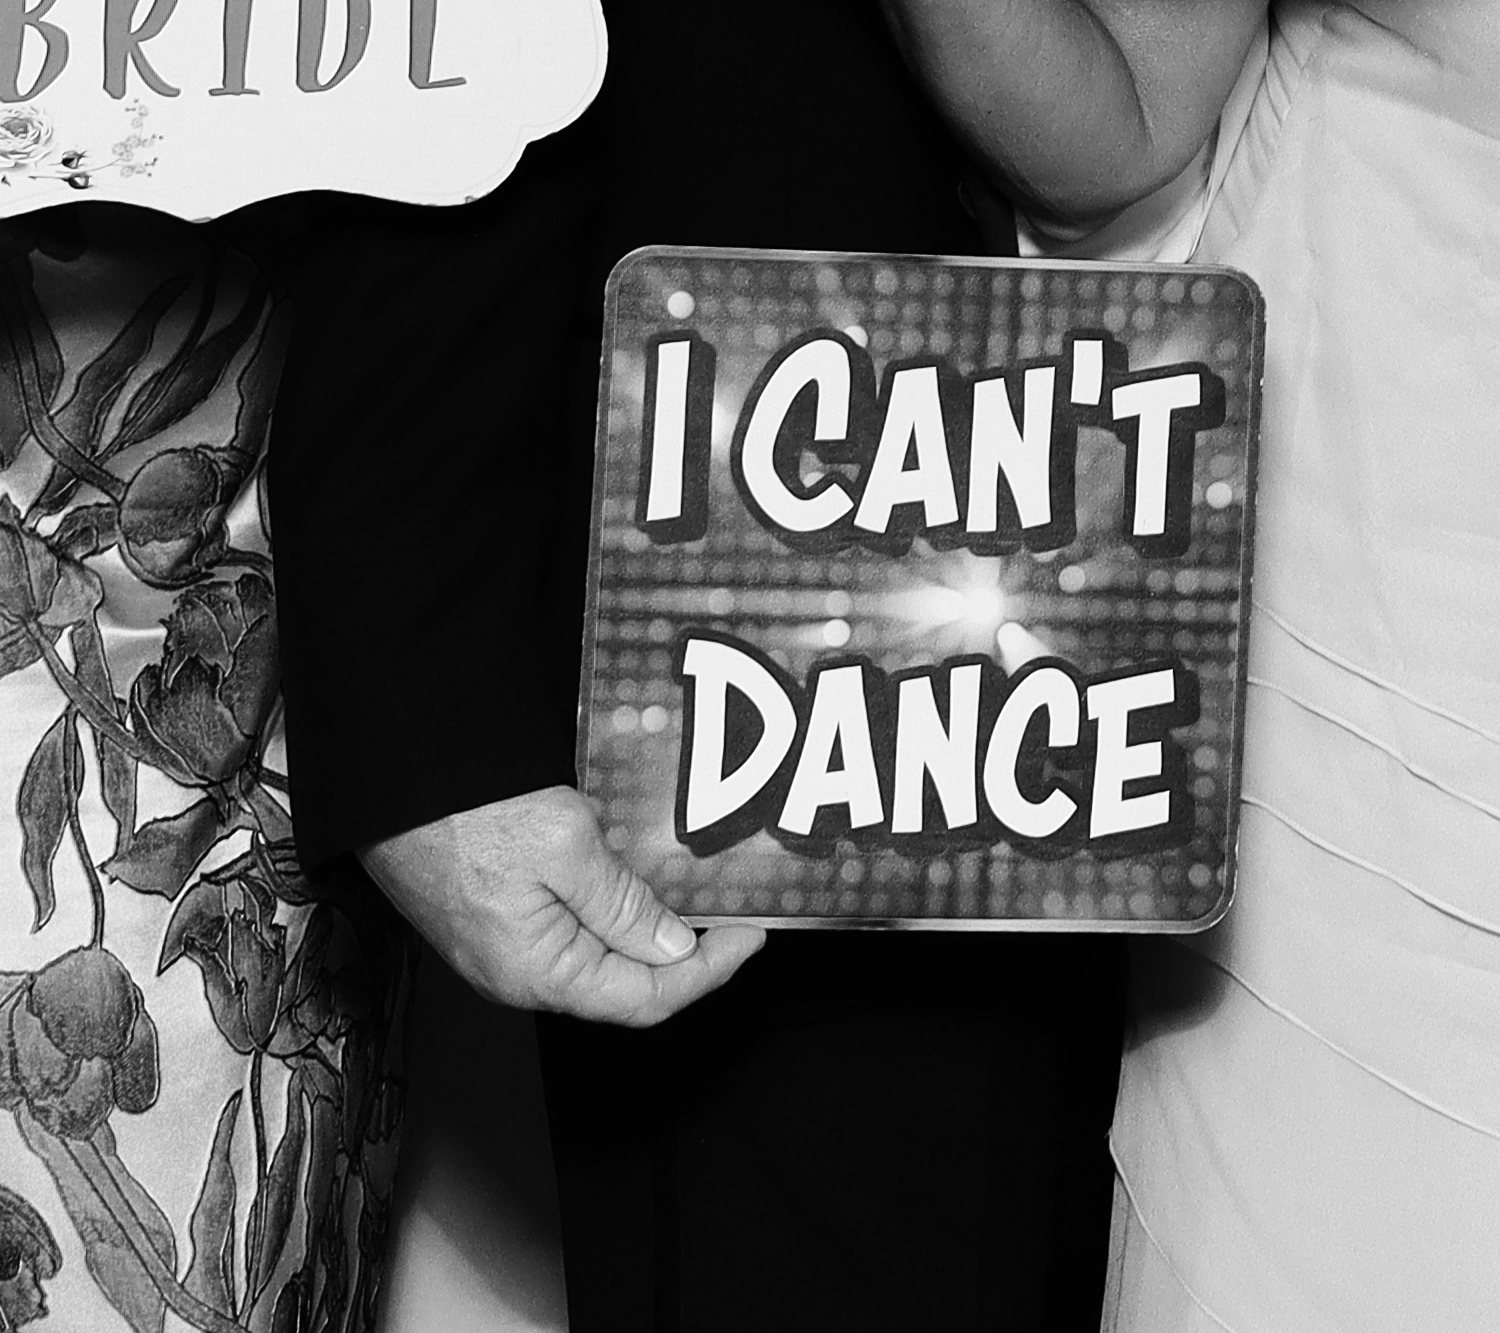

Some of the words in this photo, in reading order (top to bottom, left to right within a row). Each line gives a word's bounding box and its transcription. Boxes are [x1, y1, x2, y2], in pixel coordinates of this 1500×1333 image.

[646, 339, 692, 523] I
[741, 337, 1201, 537] CAN'T
[682, 638, 1176, 840] DANCE
